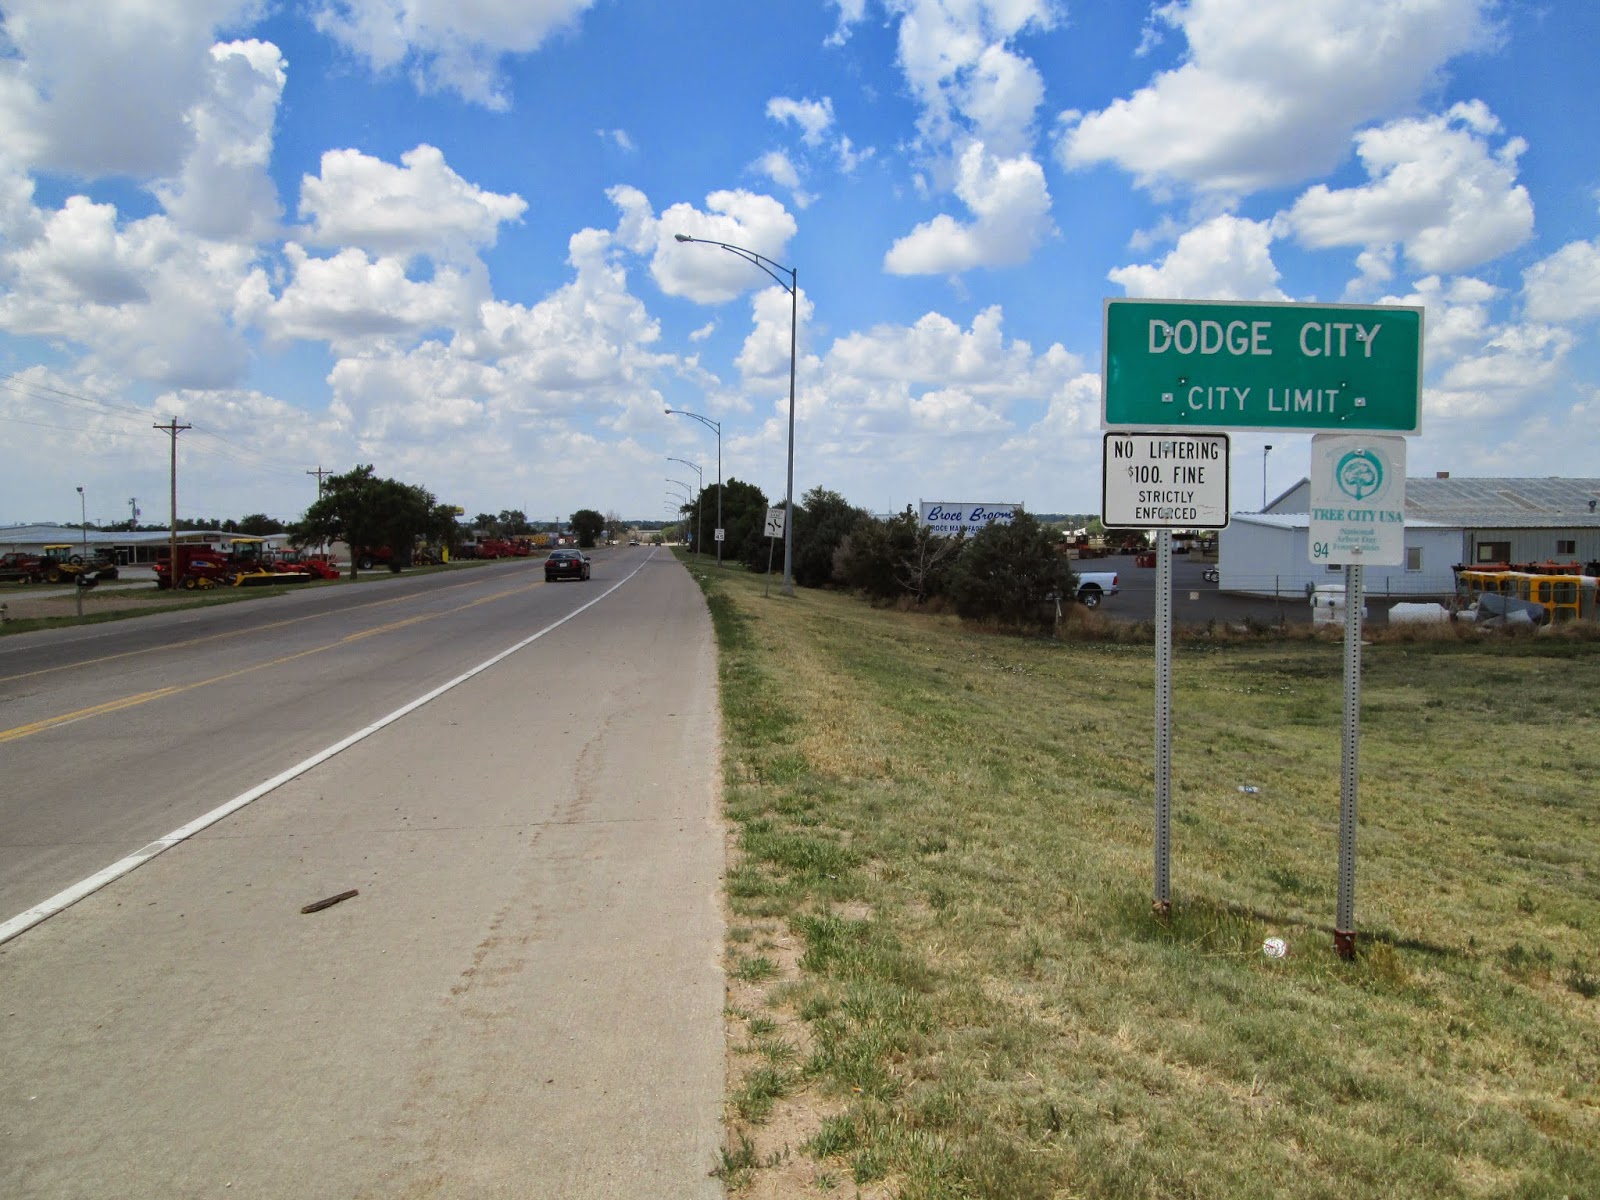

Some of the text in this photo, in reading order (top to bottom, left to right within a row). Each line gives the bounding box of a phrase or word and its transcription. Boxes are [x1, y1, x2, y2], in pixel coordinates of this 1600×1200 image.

[1149, 319, 1382, 357] DODGE CITY
[1188, 386, 1339, 413] CITY LIMIT
[1115, 441, 1133, 459] NO
[1173, 466, 1205, 484] FINE
[1139, 491, 1194, 503] STRICTLY
[928, 506, 962, 521] Broce
[1312, 508, 1403, 522] TREE CITY USA
[1314, 542, 1329, 558] 94
